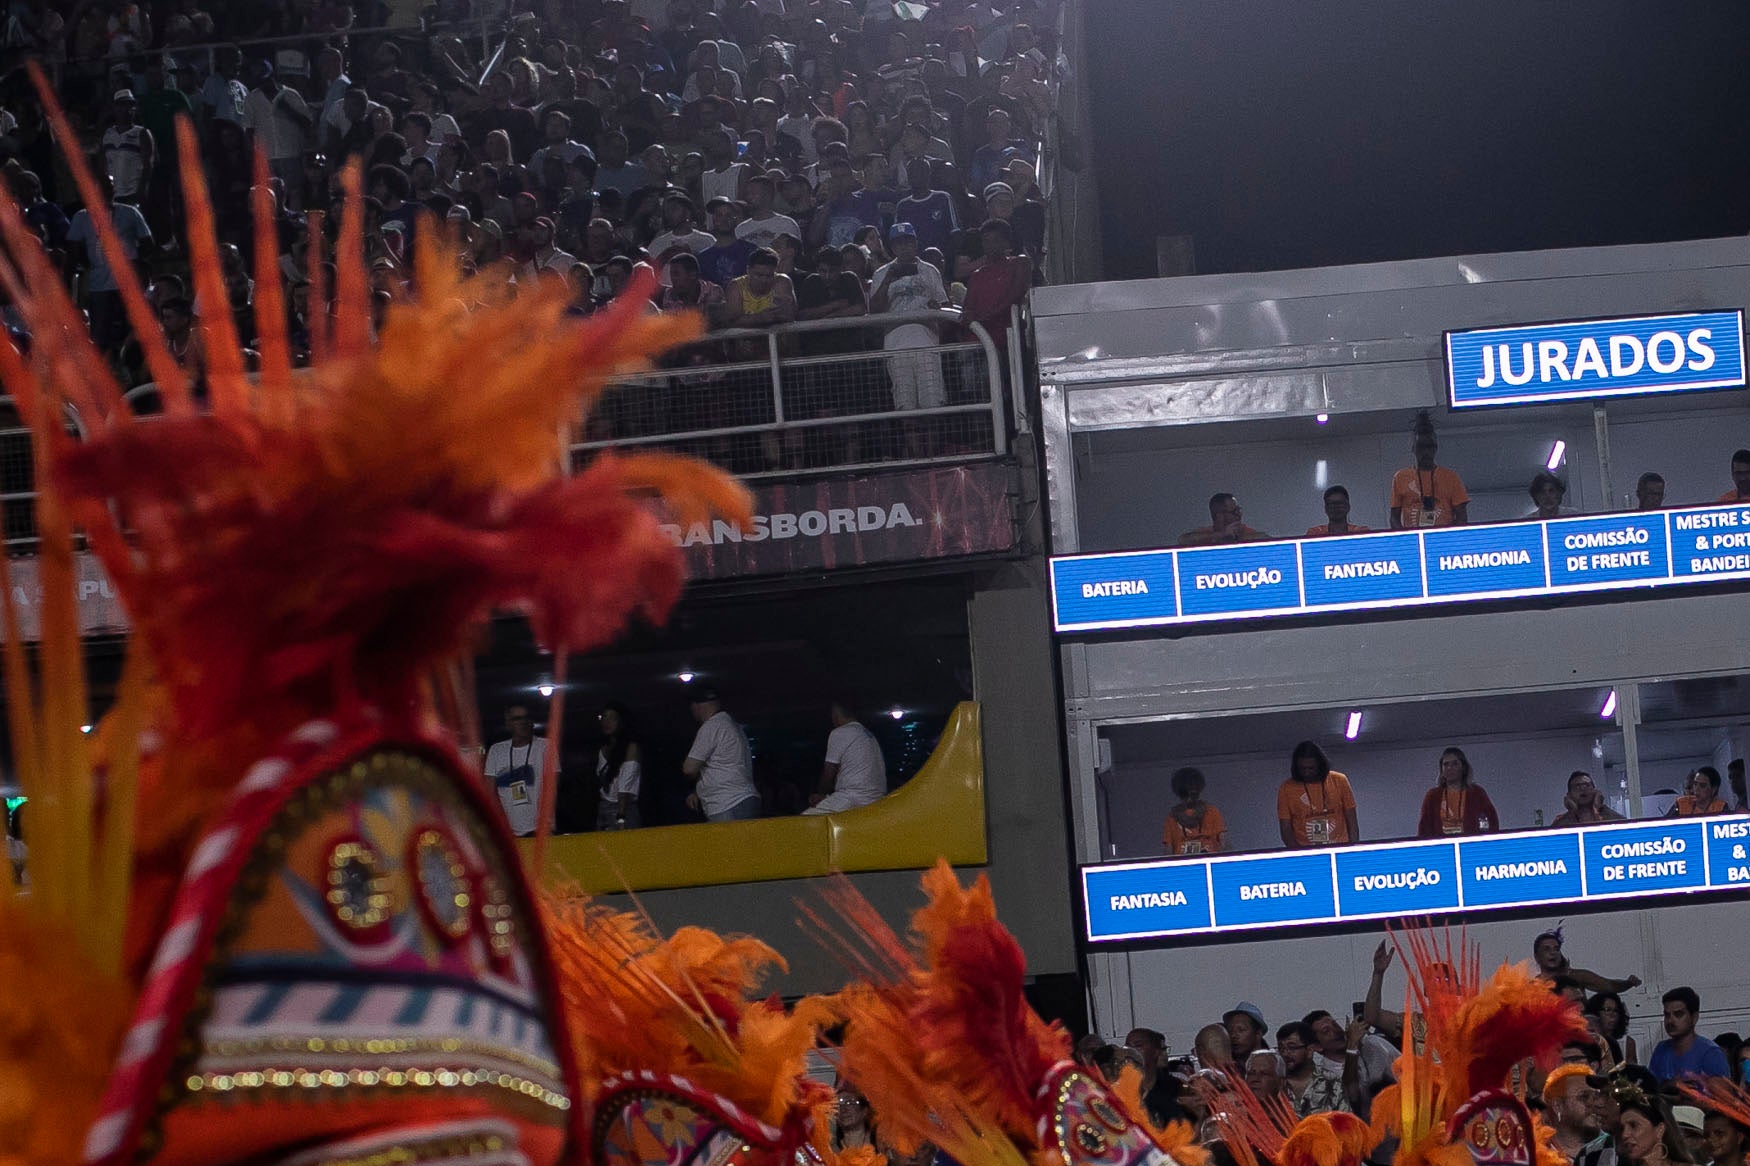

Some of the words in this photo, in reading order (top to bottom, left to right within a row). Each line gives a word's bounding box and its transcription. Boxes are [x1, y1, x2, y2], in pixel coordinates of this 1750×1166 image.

[1476, 329, 1716, 388] JURADOS
[1676, 509, 1738, 529] MESTRE
[1565, 527, 1649, 549] COMISSÃO
[1696, 536, 1709, 550] &
[1440, 550, 1530, 570] HARMONIA
[1567, 556, 1588, 571] DE
[1592, 552, 1649, 569] FRENTE
[1196, 567, 1281, 589] EVOLUÇÃO
[1325, 561, 1400, 579] FANTASIA
[1083, 580, 1148, 597] BATERIA
[1601, 837, 1685, 859] COMISSÃO
[1733, 845, 1746, 858] &
[1355, 868, 1440, 890] EVOLUÇÃO
[1476, 860, 1566, 880] HARMONIA
[1604, 866, 1624, 880] DE
[1631, 862, 1686, 878] FRENTE
[1111, 891, 1187, 910] FANTASIA
[1240, 882, 1306, 900] BATERIA
